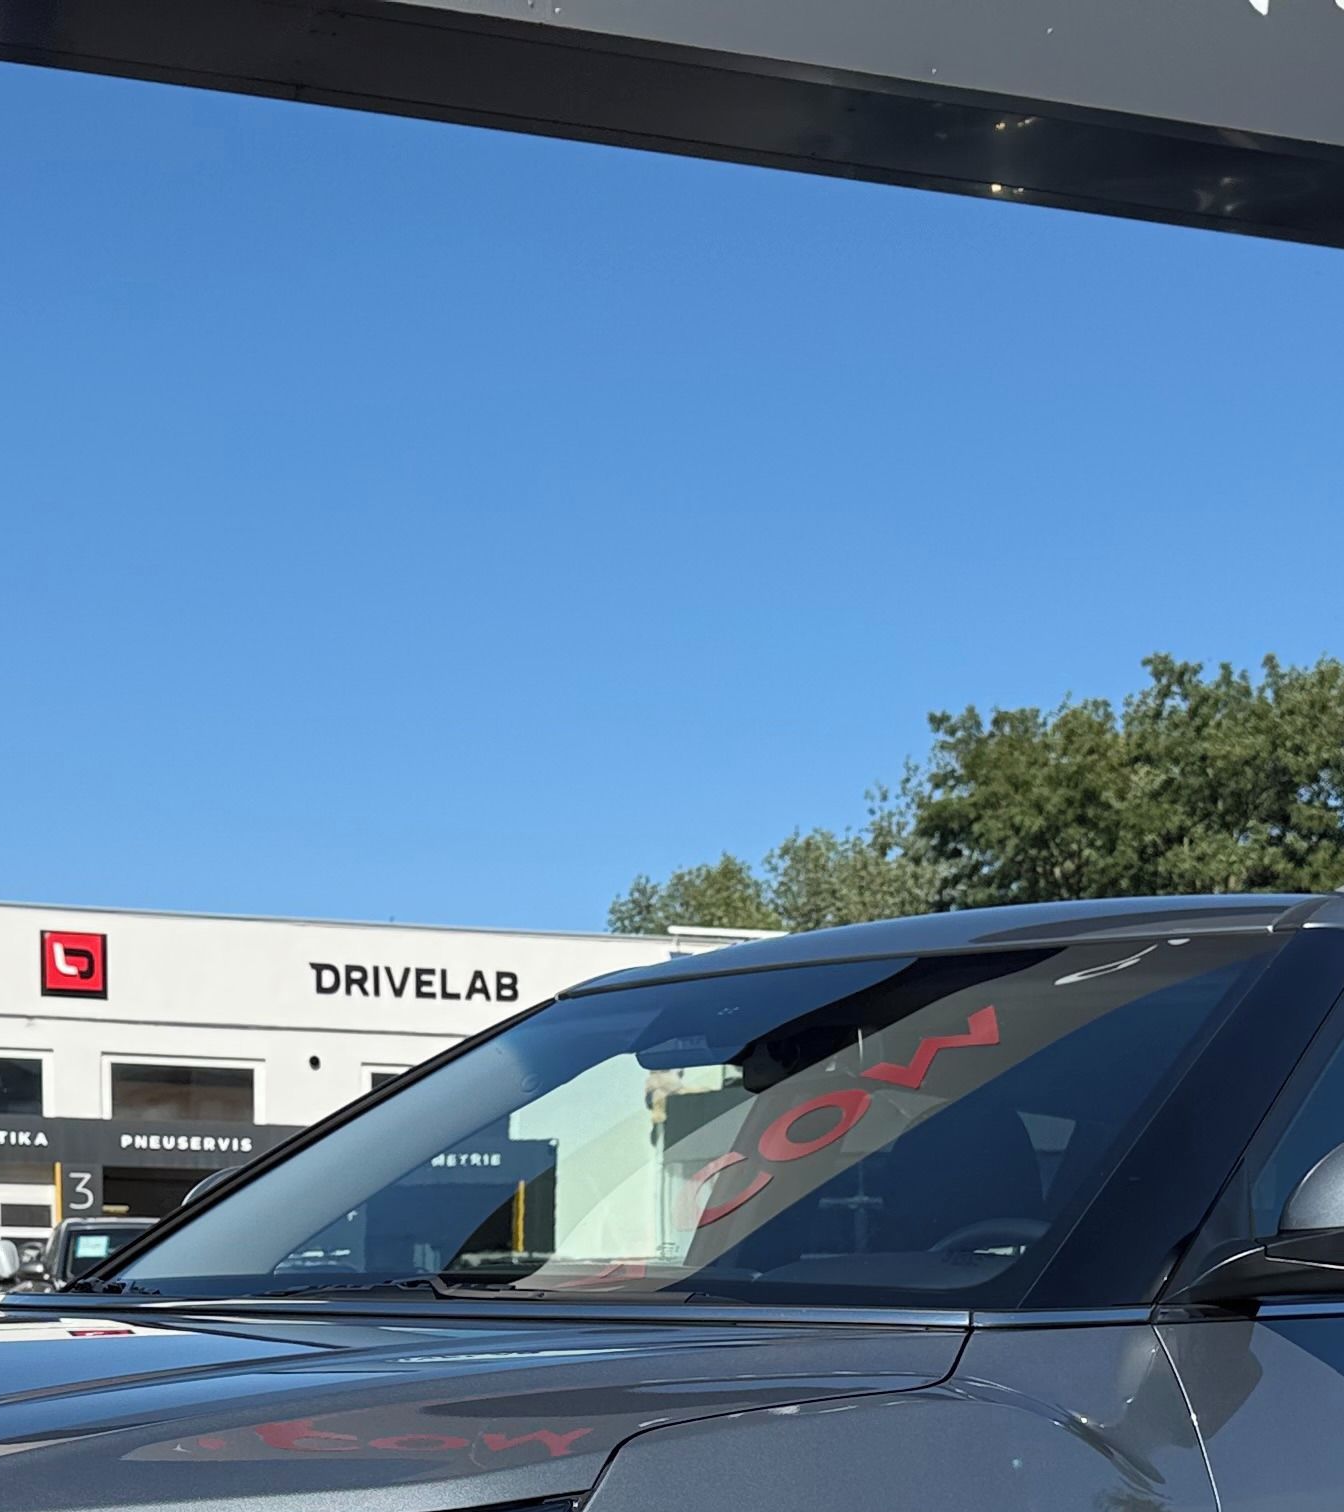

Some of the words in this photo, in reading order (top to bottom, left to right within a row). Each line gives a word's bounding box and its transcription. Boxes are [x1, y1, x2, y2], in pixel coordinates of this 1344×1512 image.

[309, 962, 520, 1002] DRIVELAB
[120, 1134, 254, 1153] PNEUSERVIS
[68, 1171, 95, 1211] 3
